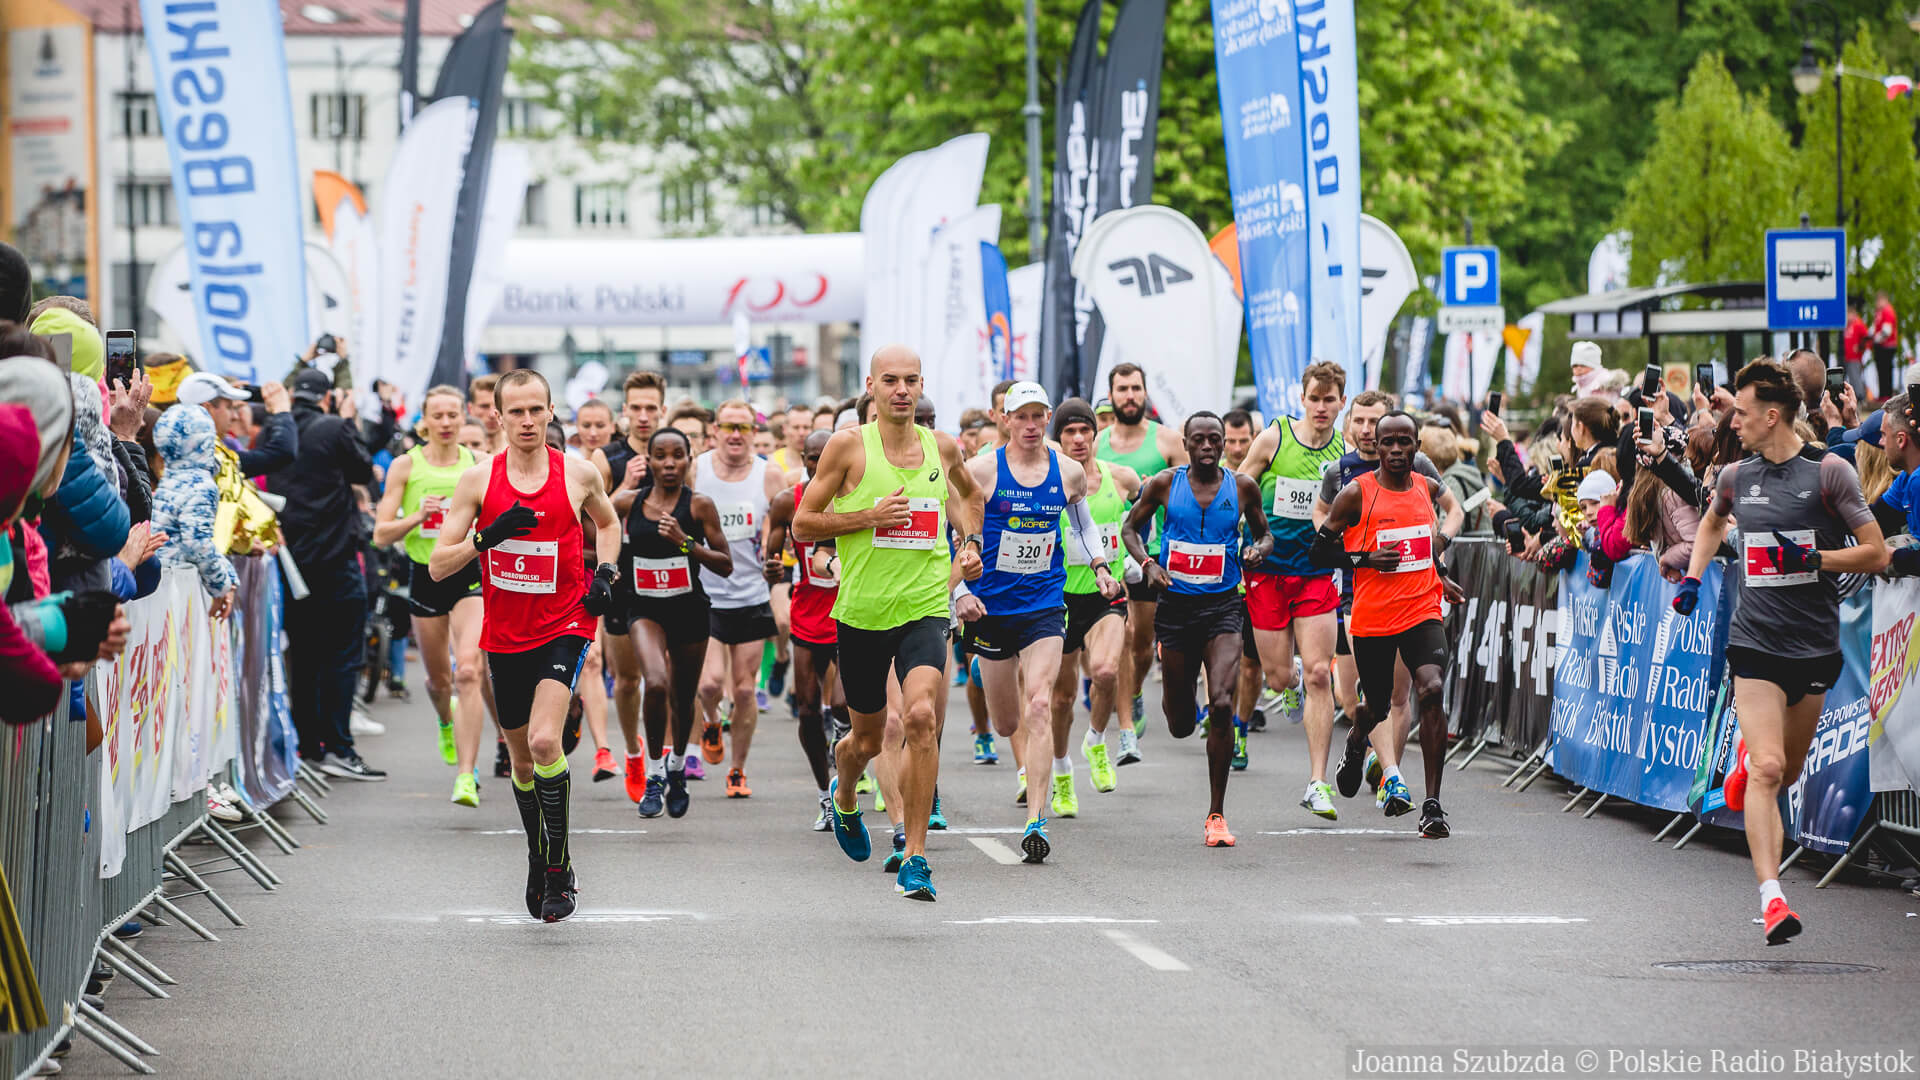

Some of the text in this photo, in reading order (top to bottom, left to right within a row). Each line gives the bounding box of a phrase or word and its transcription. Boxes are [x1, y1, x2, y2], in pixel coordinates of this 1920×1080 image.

[1455, 253, 1488, 300] P
[1290, 490, 1312, 504] 984
[723, 514, 744, 526] 270
[1016, 545, 1041, 558] 320
[1403, 540, 1412, 555] 3
[515, 556, 526, 573] 6
[1188, 556, 1205, 569] 17
[500, 570, 540, 581] DOBROWOLSKI
[652, 570, 670, 583] 10
